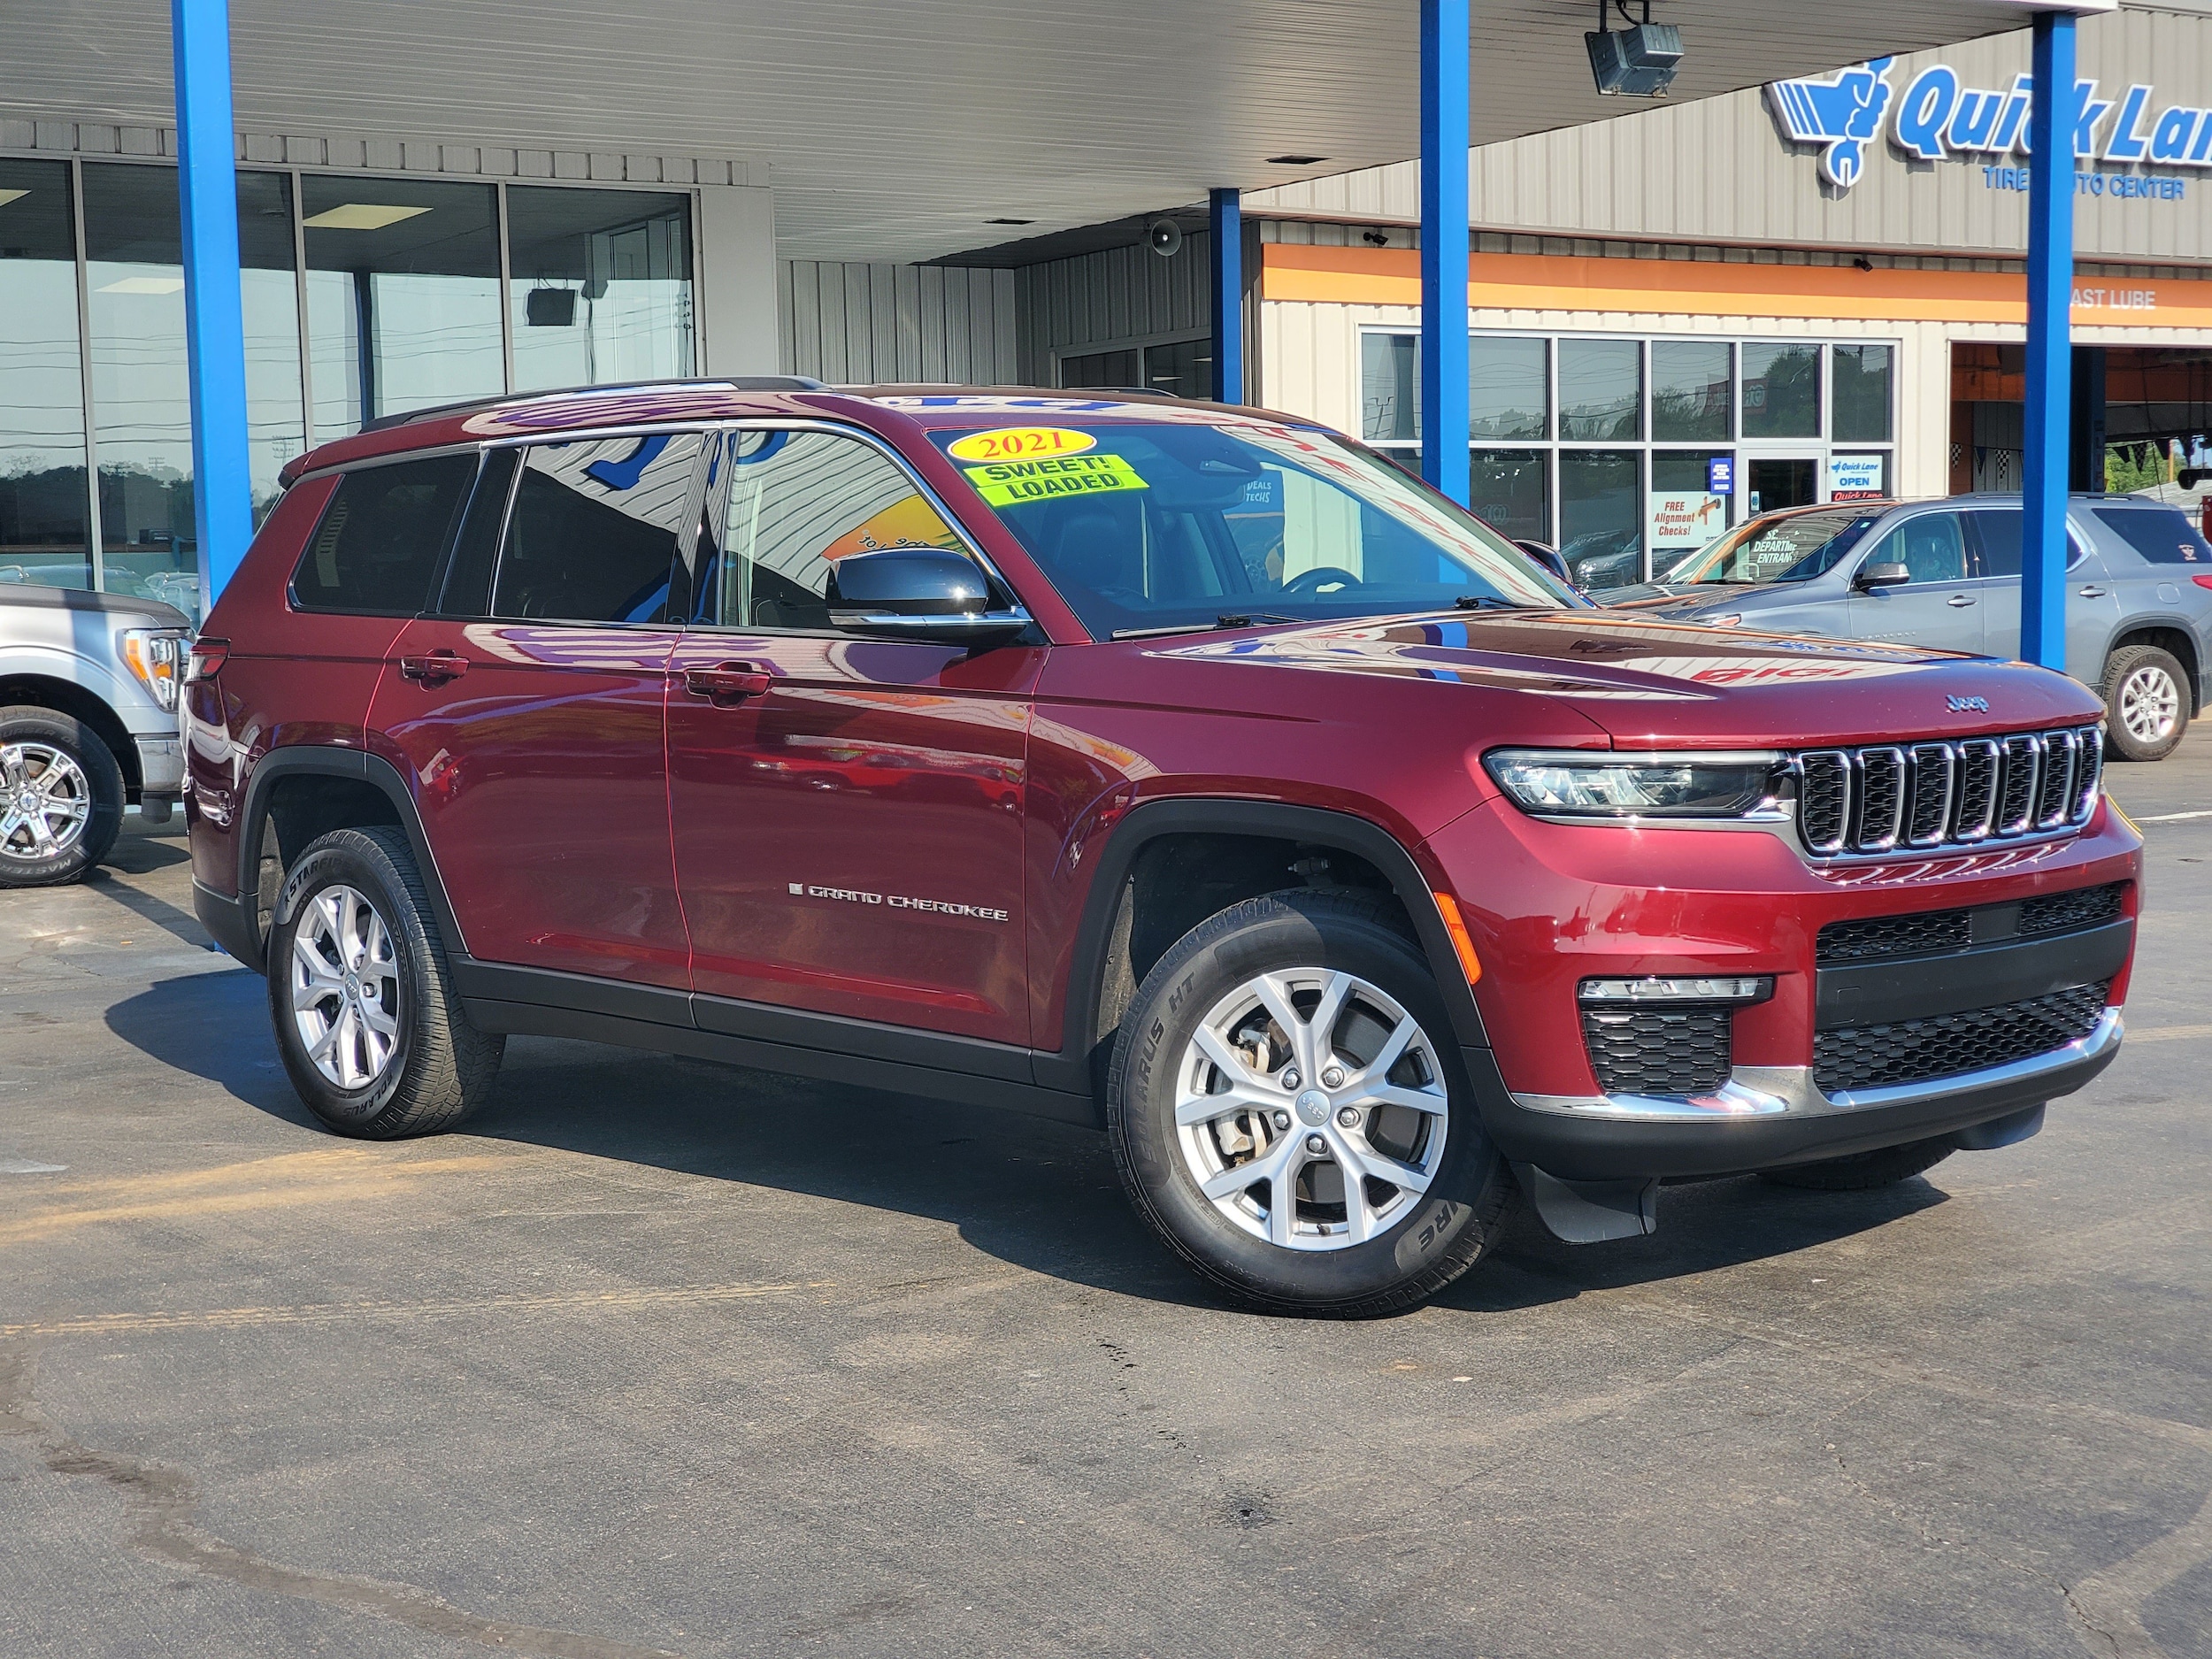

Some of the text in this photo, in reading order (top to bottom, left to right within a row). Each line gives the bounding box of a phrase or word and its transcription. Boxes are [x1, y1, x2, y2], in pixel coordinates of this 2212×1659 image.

[1983, 166, 2030, 191] TIRE
[2109, 175, 2185, 200] CENTER
[2070, 288, 2156, 310] AST LUBE
[979, 431, 1067, 458] 2021
[984, 457, 1110, 480] SWEET!
[1841, 462, 1861, 471] Quick
[1005, 472, 1121, 499] LOADED
[1246, 491, 1271, 503] TECHS
[1664, 501, 1686, 511] FREE
[1654, 512, 1695, 525] Alignment
[1658, 526, 1692, 536] Checks!
[1946, 694, 1990, 714] Jeep
[807, 885, 1009, 922] GRAND CHEROKEE
